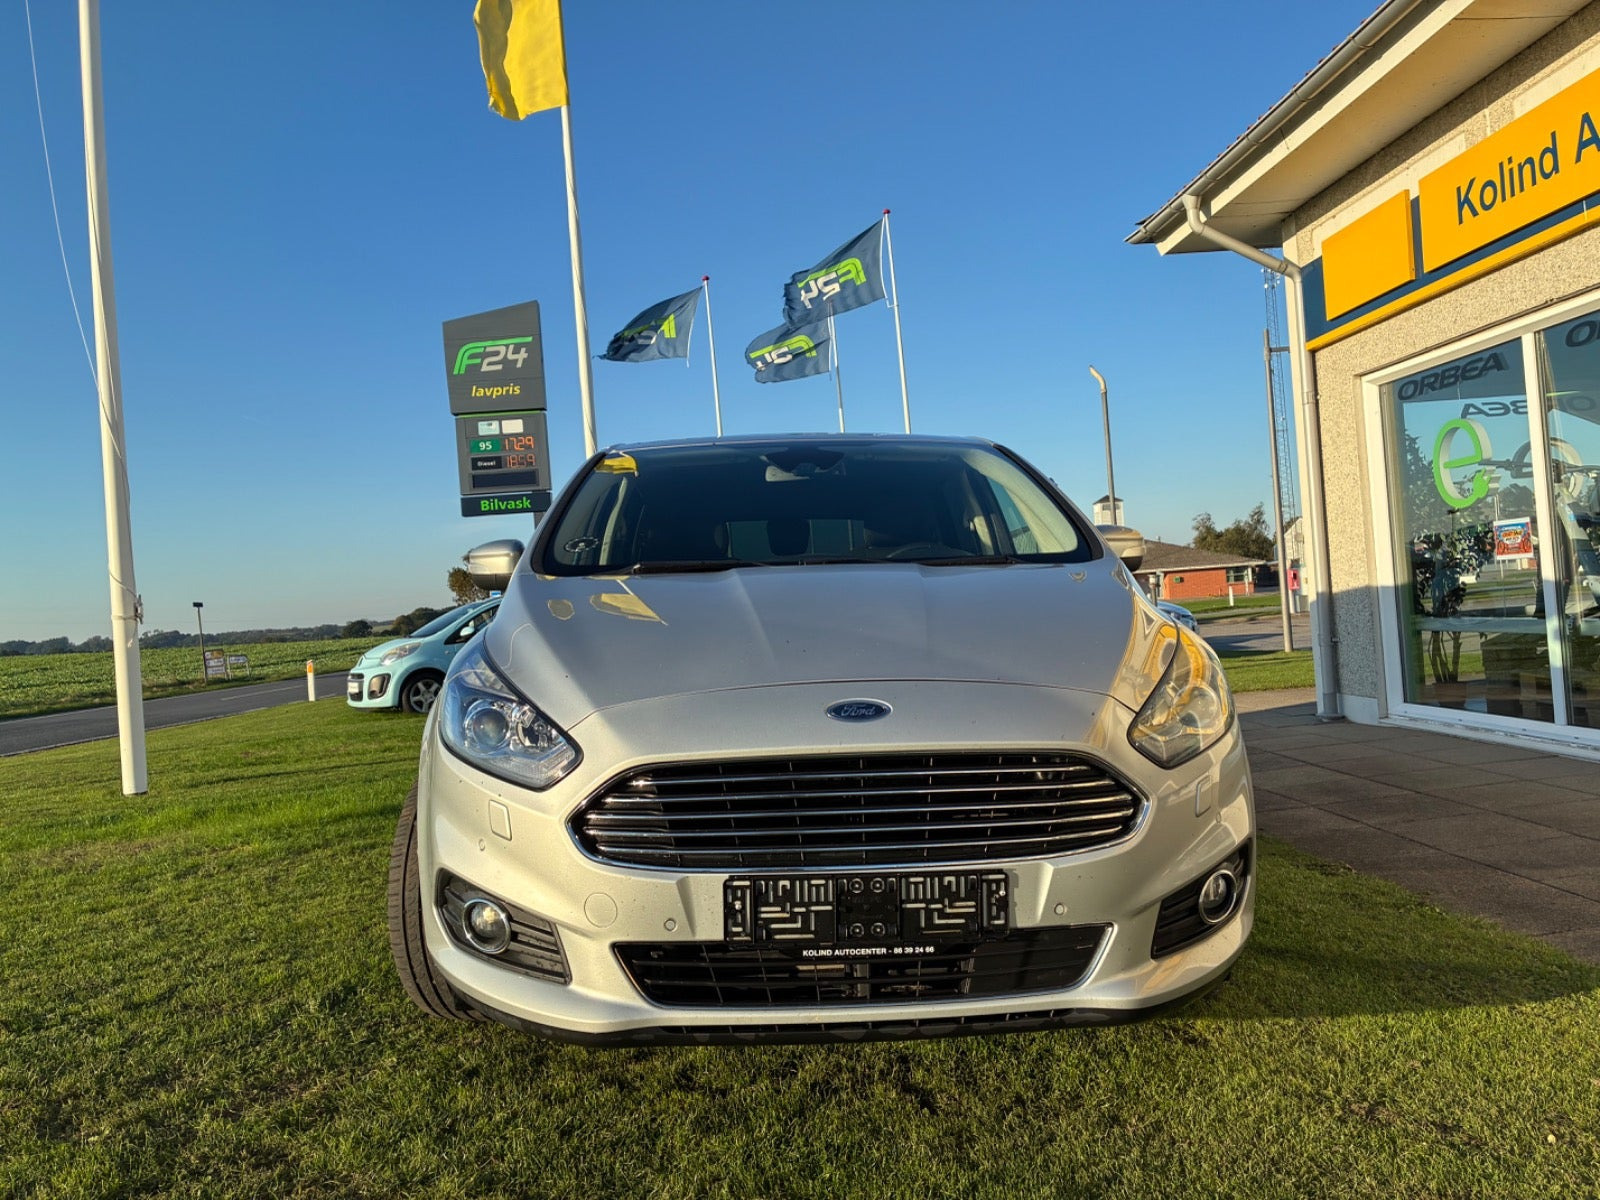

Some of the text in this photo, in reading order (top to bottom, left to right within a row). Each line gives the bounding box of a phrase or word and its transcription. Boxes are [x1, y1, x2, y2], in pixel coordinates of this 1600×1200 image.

[1456, 131, 1560, 225] Kolind
[453, 336, 533, 375] F24
[1398, 352, 1509, 400] ORBEA
[471, 383, 521, 399] lavpris
[478, 441, 493, 451] 95
[480, 496, 532, 512] Bilvask
[841, 704, 876, 717] Ford
[802, 949, 833, 957] KOLIND
[834, 947, 887, 956] AUTOCENTER
